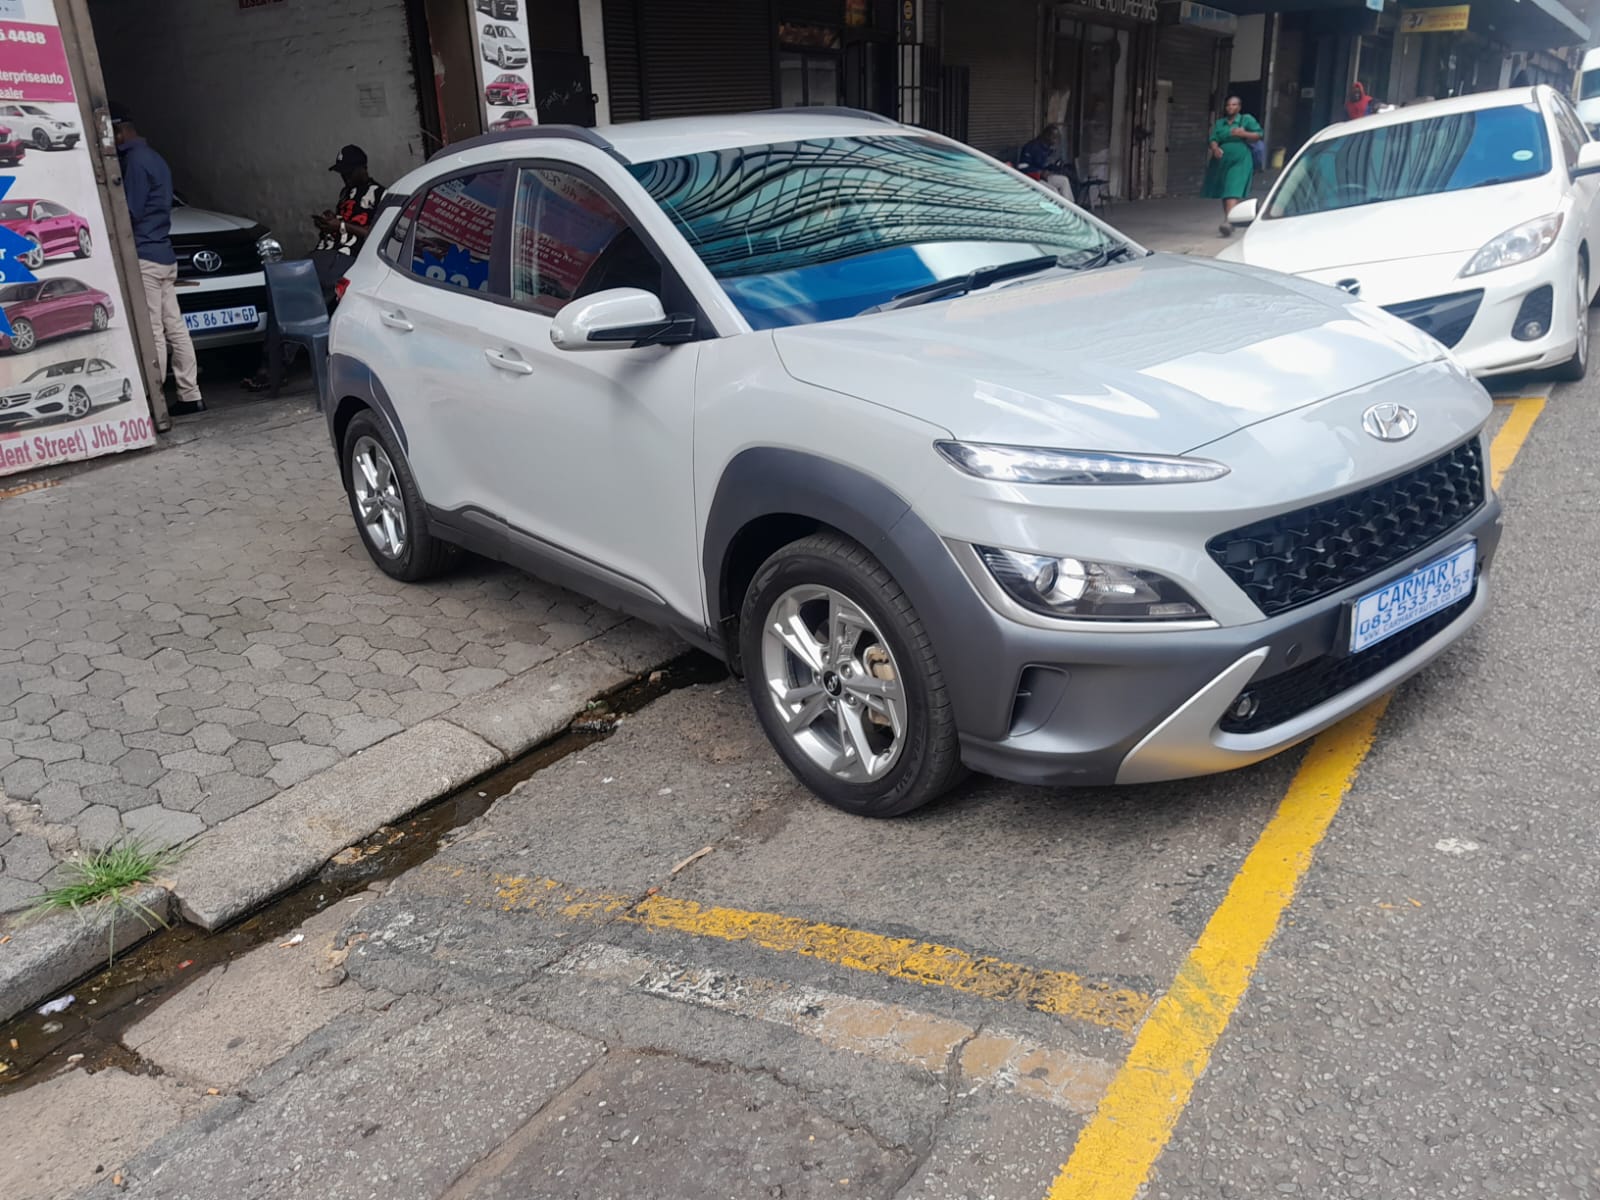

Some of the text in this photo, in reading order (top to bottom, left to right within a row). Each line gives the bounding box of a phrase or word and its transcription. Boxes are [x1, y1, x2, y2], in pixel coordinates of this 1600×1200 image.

[8, 29, 47, 45] 4488
[203, 312, 218, 327] 86
[220, 310, 234, 324] ZV
[241, 307, 255, 321] GP
[92, 423, 118, 449] Jhb
[119, 416, 156, 443] 2001
[1377, 556, 1460, 612] CARMART
[1359, 569, 1470, 636] 083 533 3653
